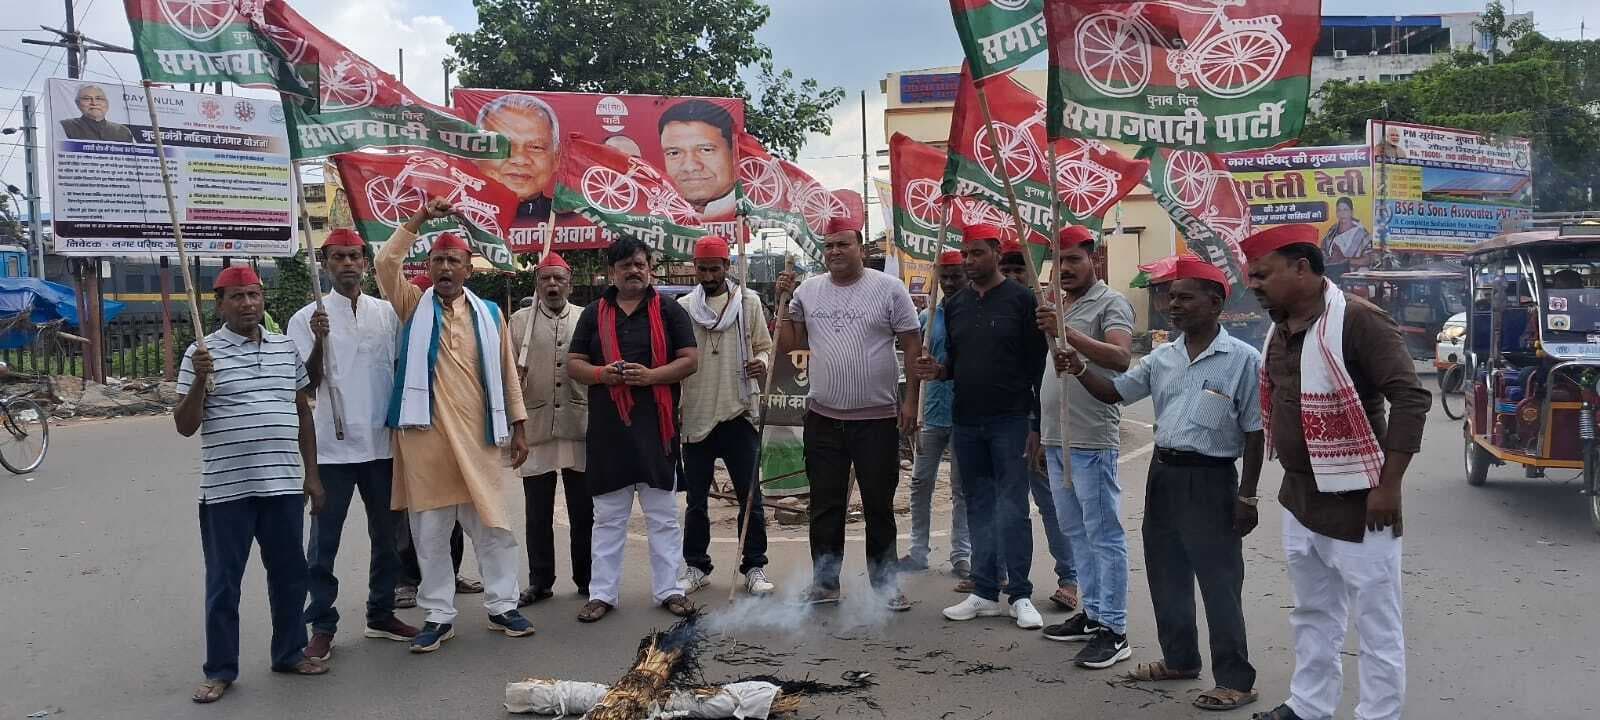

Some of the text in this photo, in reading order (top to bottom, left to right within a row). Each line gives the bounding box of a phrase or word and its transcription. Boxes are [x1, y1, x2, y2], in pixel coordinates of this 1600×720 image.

[123, 93, 184, 107] DAY NULM
[1146, 93, 1199, 109] चुनाव चिन्ह
[401, 111, 425, 121] चिन्ह
[1063, 99, 1287, 145] समाजवादी पार्टी
[184, 130, 211, 144] महिला
[213, 134, 242, 146] रोजगार
[244, 136, 269, 149] योजना
[297, 120, 431, 149] समाजवादी
[1403, 130, 1417, 138] PM
[1228, 151, 1366, 168] नगर परिषद् की मुख्य पार्षद
[1314, 169, 1367, 197] देवी
[1024, 185, 1045, 199] चुनाव
[1394, 201, 1414, 215] BSA
[1427, 204, 1448, 217] Sons
[1451, 206, 1493, 221] Associates
[553, 225, 597, 245] अवाम
[66, 239, 102, 249] निवेदक
[112, 241, 134, 249] नगर
